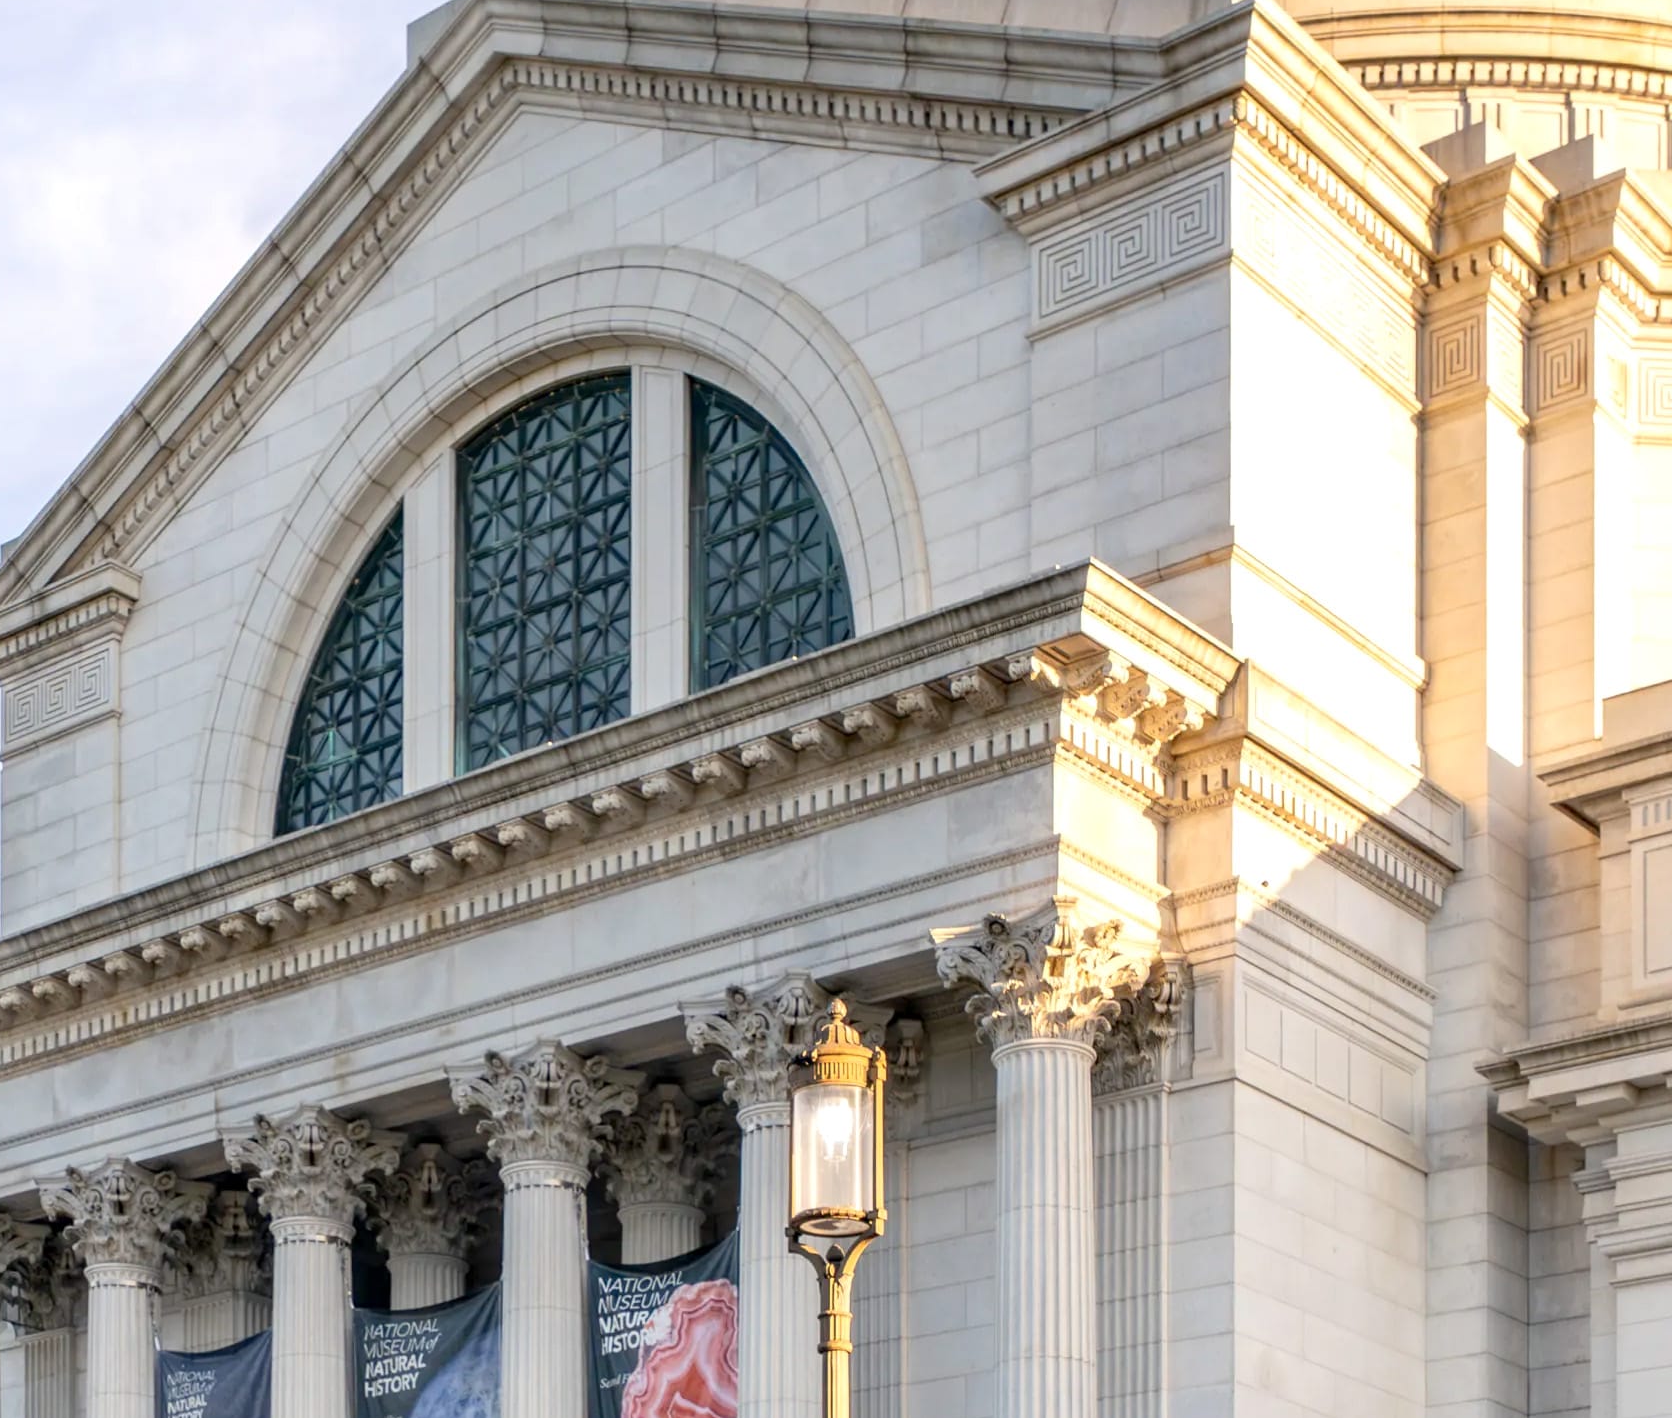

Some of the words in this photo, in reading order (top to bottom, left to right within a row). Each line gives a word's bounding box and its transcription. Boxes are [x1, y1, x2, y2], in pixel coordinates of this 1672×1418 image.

[598, 1271, 684, 1294] NATIONAL
[364, 1319, 439, 1341] NATIONAL
[366, 1353, 426, 1379] NATURAL
[167, 1369, 216, 1386] NATIONAL
[365, 1372, 419, 1398] HSTORY
[167, 1394, 207, 1414] NATURAL
